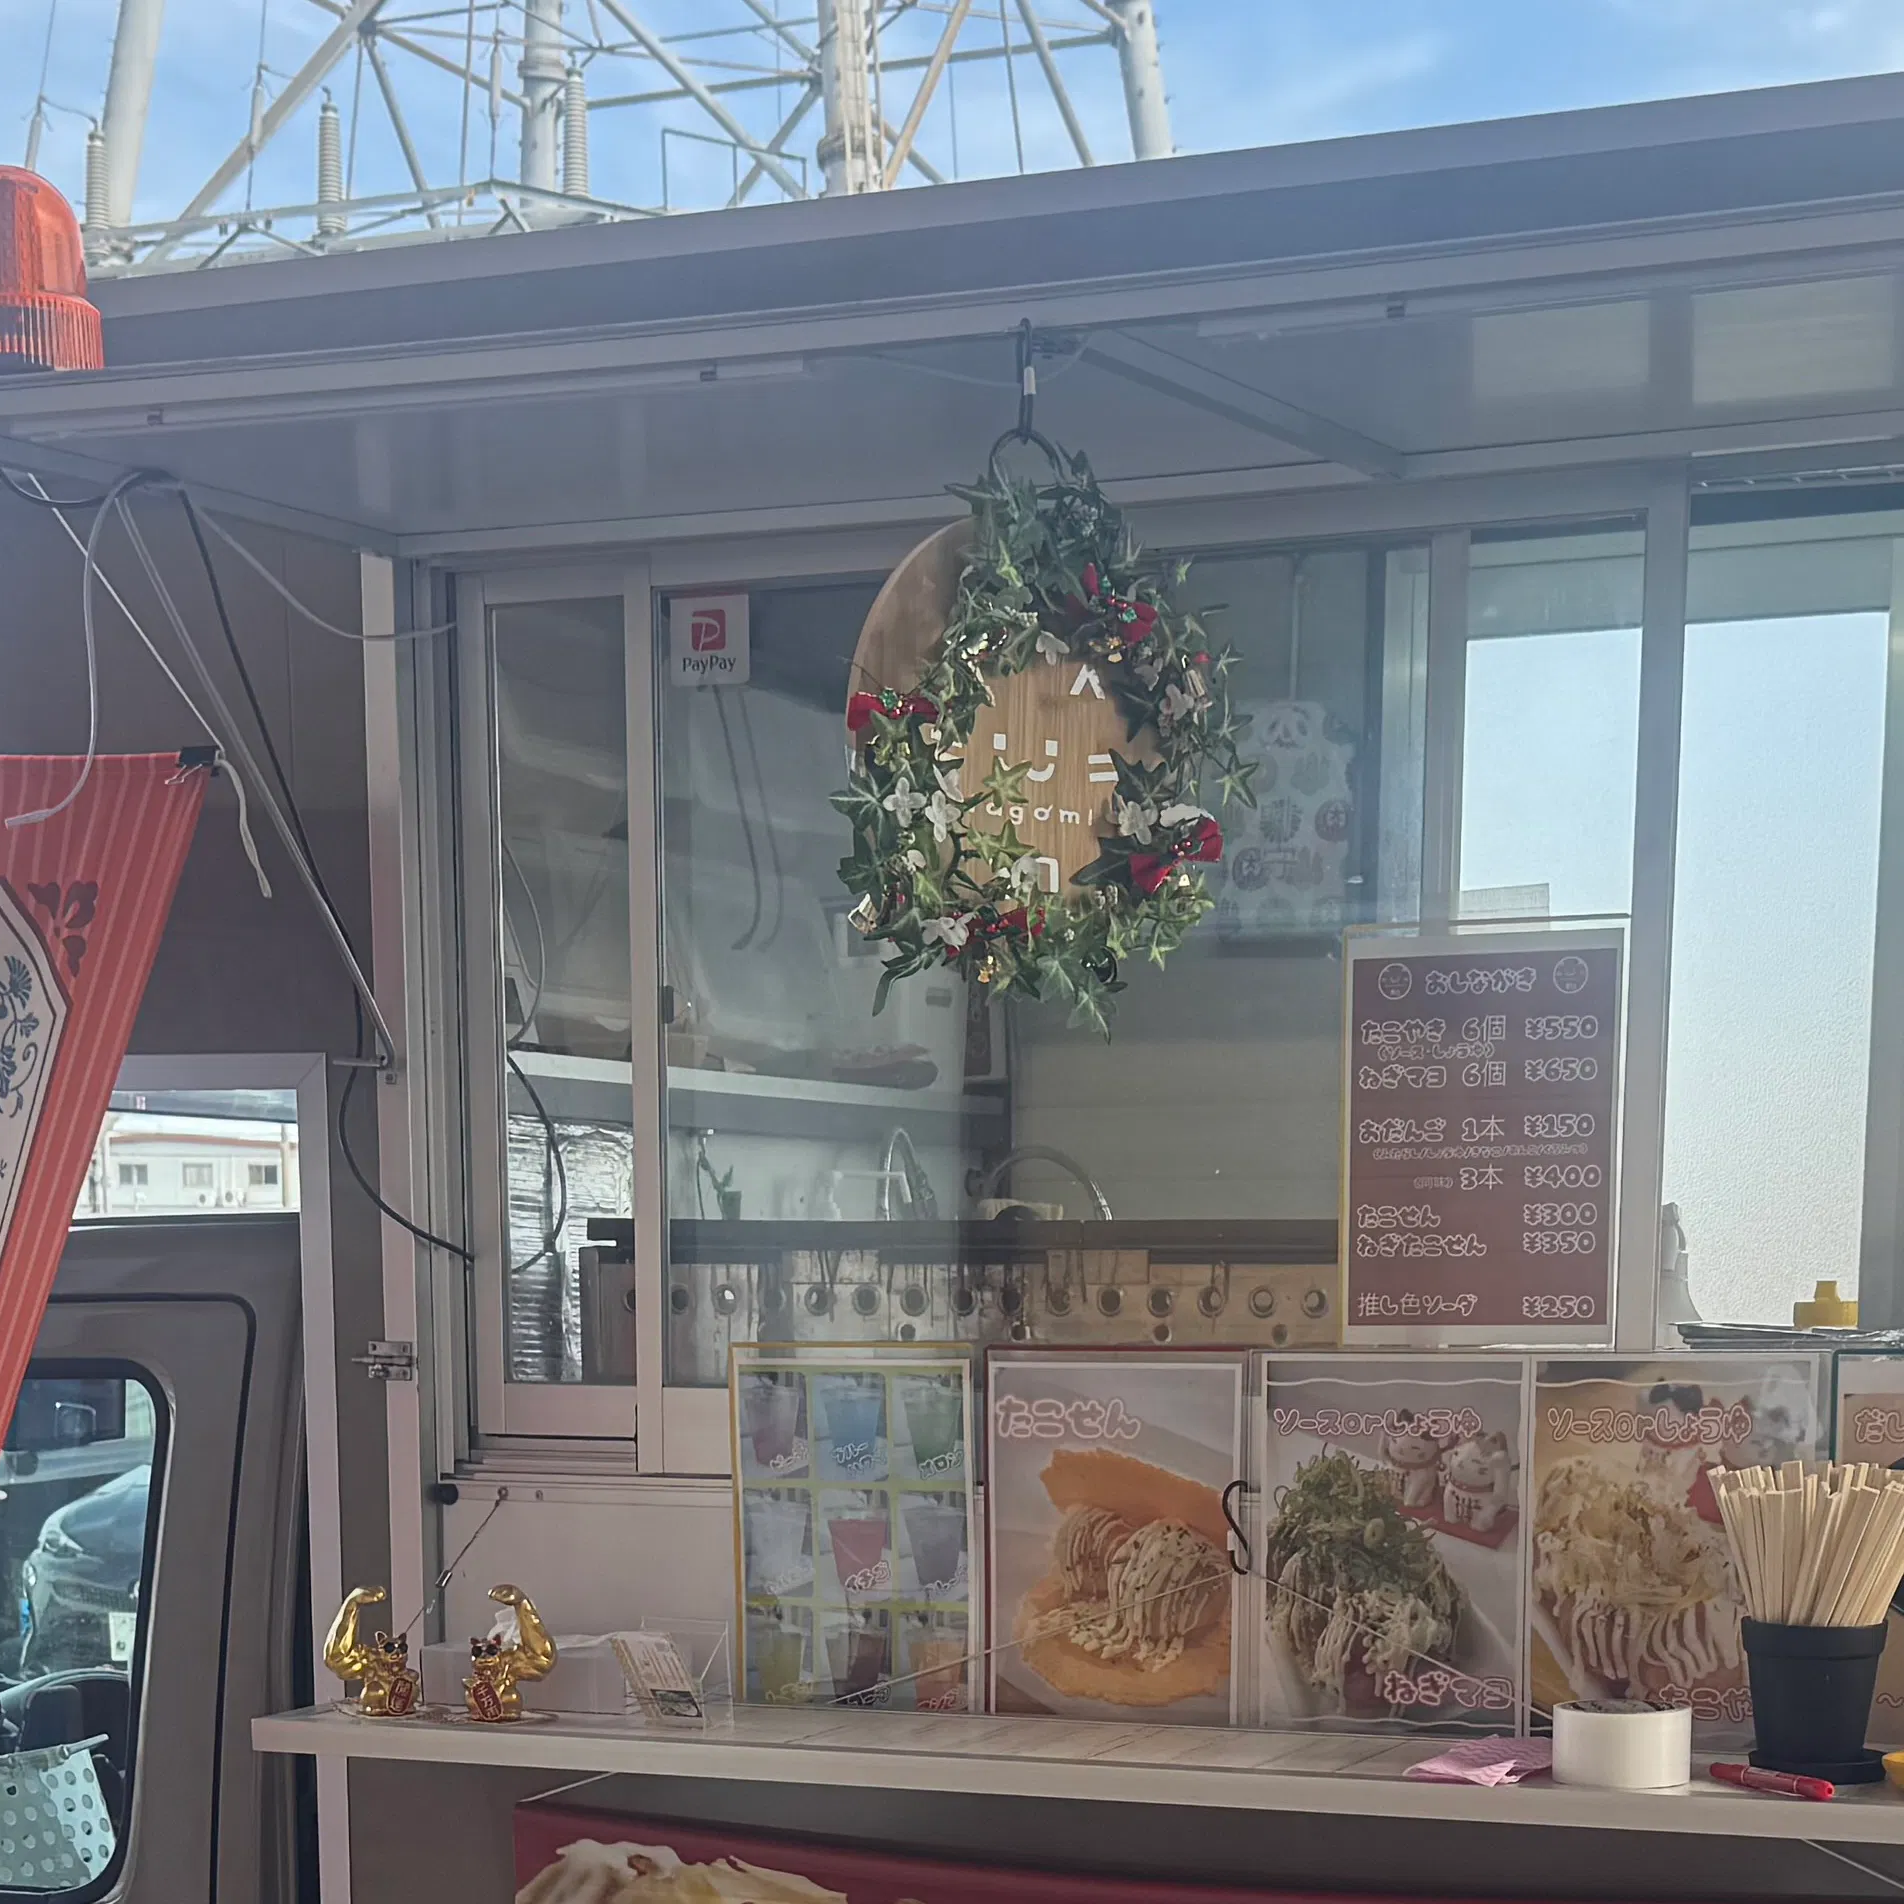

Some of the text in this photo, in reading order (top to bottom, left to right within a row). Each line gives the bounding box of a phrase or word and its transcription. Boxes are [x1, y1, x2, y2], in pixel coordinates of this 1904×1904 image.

[682, 655, 736, 675] PayPay
[968, 803, 1093, 826] agomi
[1425, 967, 1536, 995] おしながき
[1361, 1015, 1598, 1044] たこやき 6個 ¥550
[1359, 1057, 1598, 1089] ねぎマヨ 6個 ¥650
[1359, 1113, 1595, 1143] おだんご 1本 ¥150
[1460, 1163, 1504, 1190] 3本
[1524, 1164, 1601, 1189] ¥400
[1357, 1202, 1597, 1228] たこせん ¥300
[1357, 1231, 1596, 1257] ねぎたこせん ¥350
[1358, 1292, 1594, 1318] 推し色ソーダ ¥250
[996, 1395, 1141, 1439] たこせん
[1272, 1408, 1484, 1440] ソースorしょうゆ
[1547, 1406, 1756, 1445] ソースorしょうゆ
[1383, 1671, 1513, 1709] ねぎマヨ
